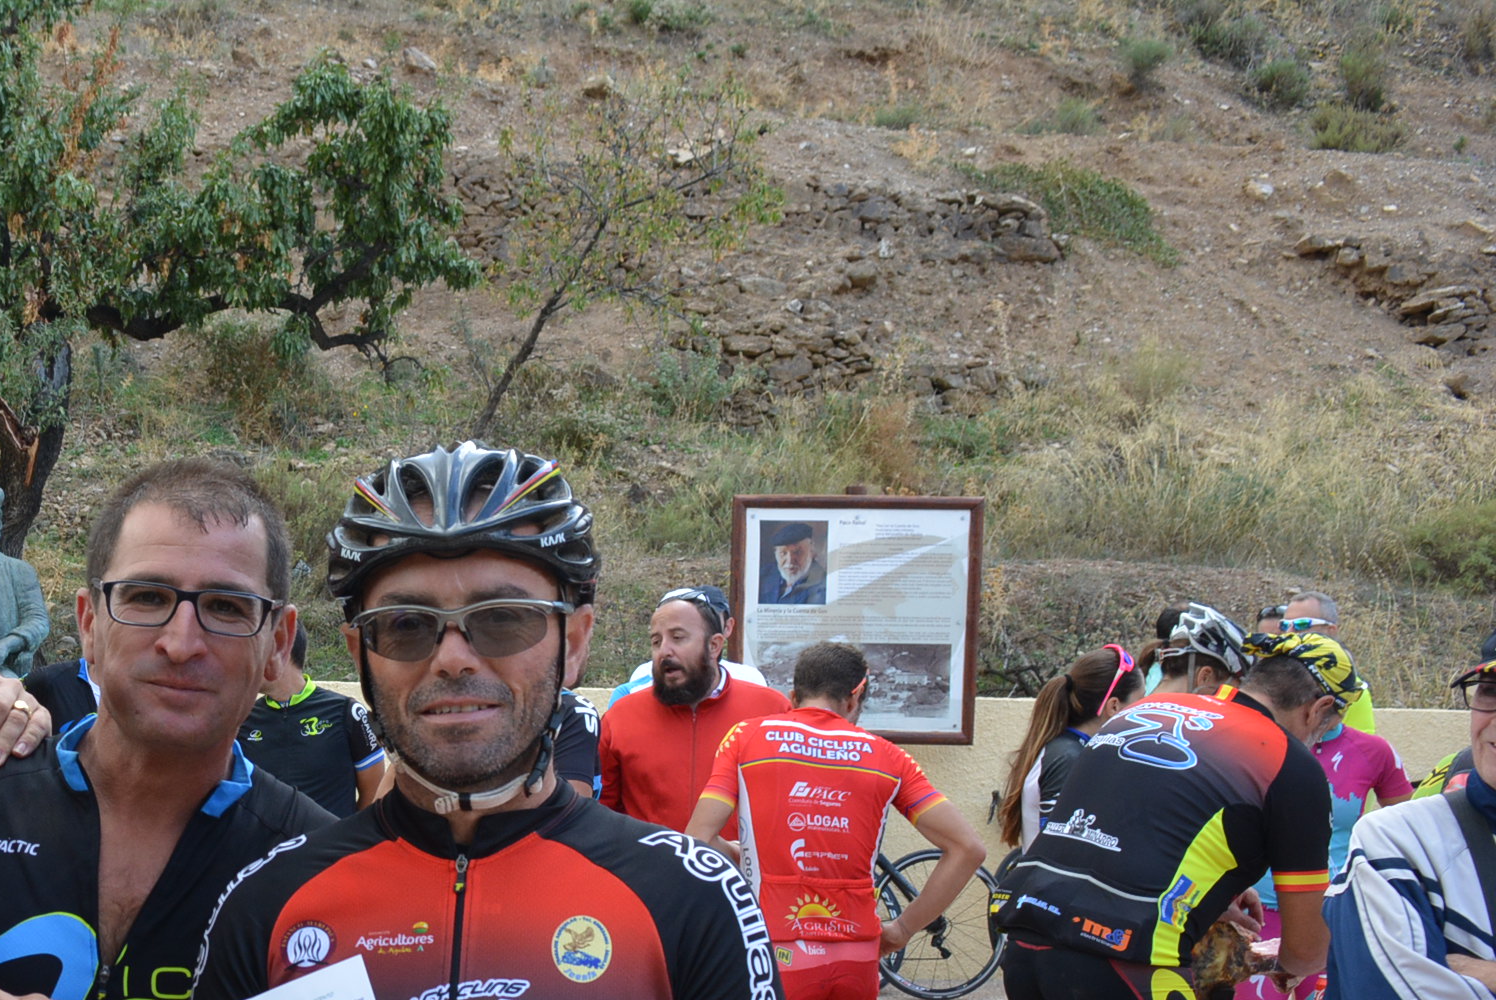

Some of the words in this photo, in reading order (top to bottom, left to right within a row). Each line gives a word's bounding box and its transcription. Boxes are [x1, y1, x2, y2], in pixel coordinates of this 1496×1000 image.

[540, 532, 566, 548] KASK
[340, 548, 361, 562] KASK
[765, 730, 805, 743] CLUB
[808, 735, 873, 754] CICLISTA
[778, 741, 861, 762] AGUILEÑO
[806, 813, 850, 829] LOGAR
[355, 932, 434, 950] Agricultores
